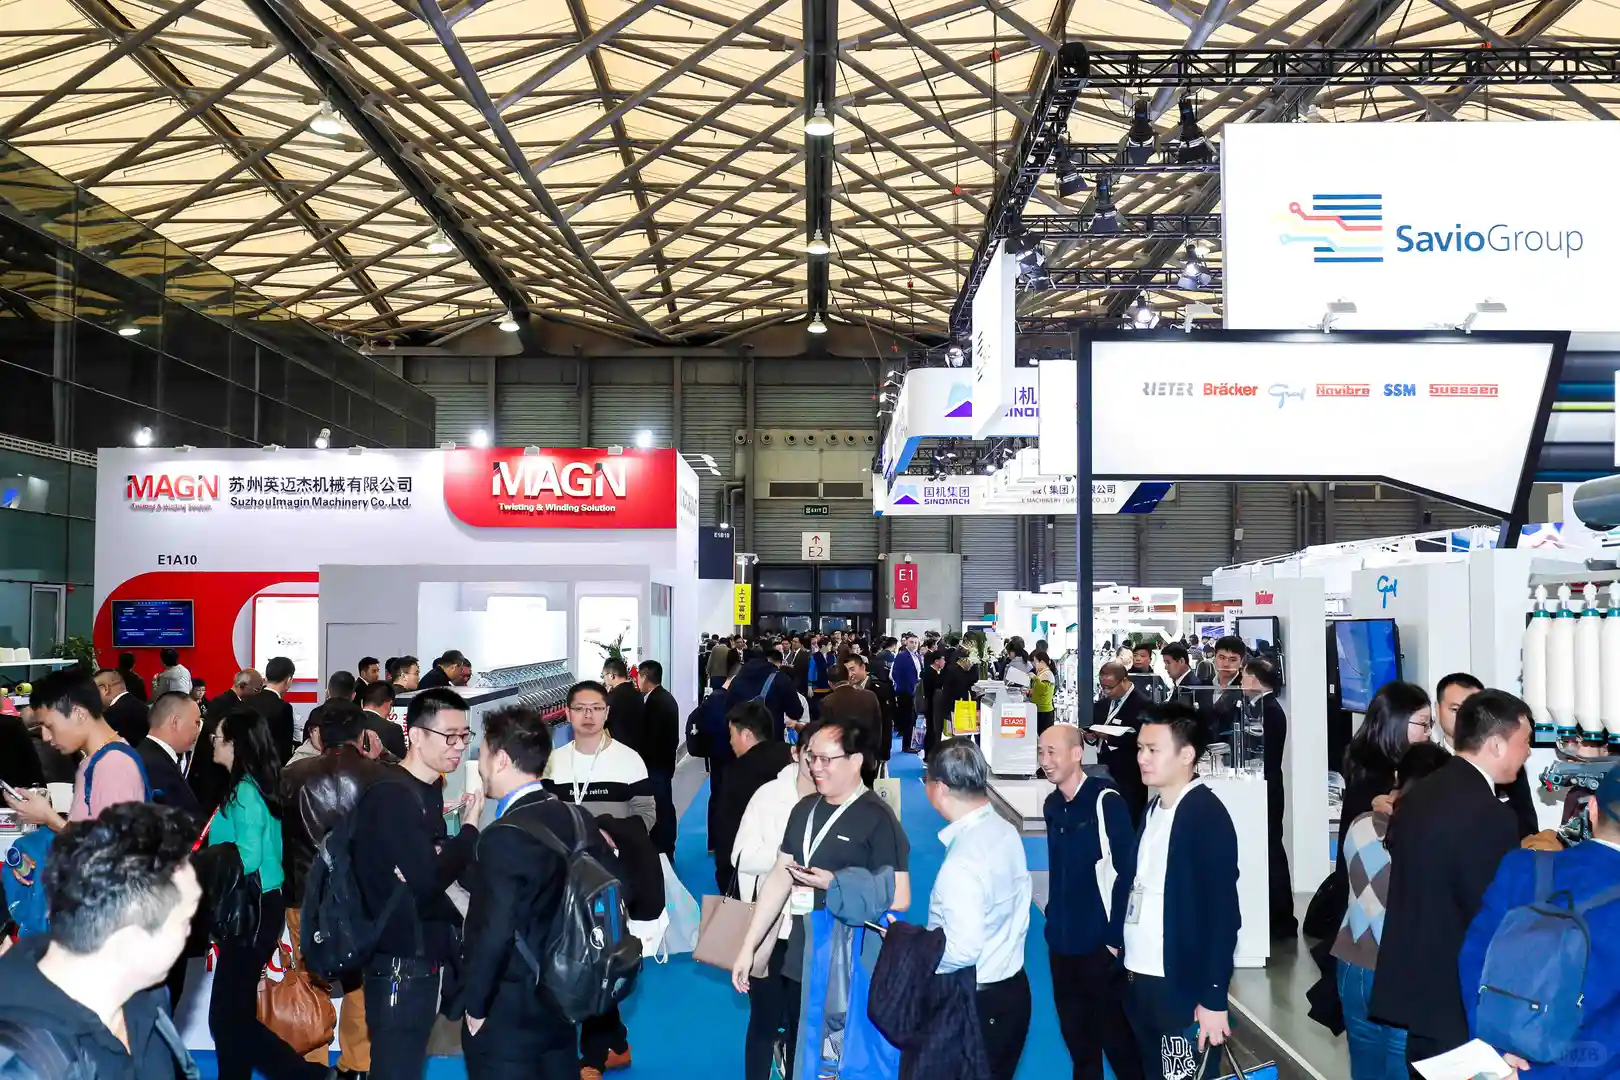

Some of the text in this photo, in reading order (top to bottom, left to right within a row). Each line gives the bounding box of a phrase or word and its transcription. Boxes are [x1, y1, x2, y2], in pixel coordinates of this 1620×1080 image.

[1396, 223, 1584, 258] SavioGroup
[1142, 382, 1194, 396] RIETER
[1203, 382, 1258, 396] Bräcker
[1383, 383, 1416, 396] SSM
[1429, 384, 1498, 397] Suessen
[229, 476, 412, 492] 苏州英迈杰机械有限公司
[924, 486, 970, 498] 国机集团
[312, 497, 368, 508] Machinery
[499, 503, 616, 512] Twisting & Winding Solution
[808, 546, 823, 558] E2
[157, 555, 198, 565] E1A10
[899, 569, 913, 580] E1
[901, 592, 909, 603] 6
